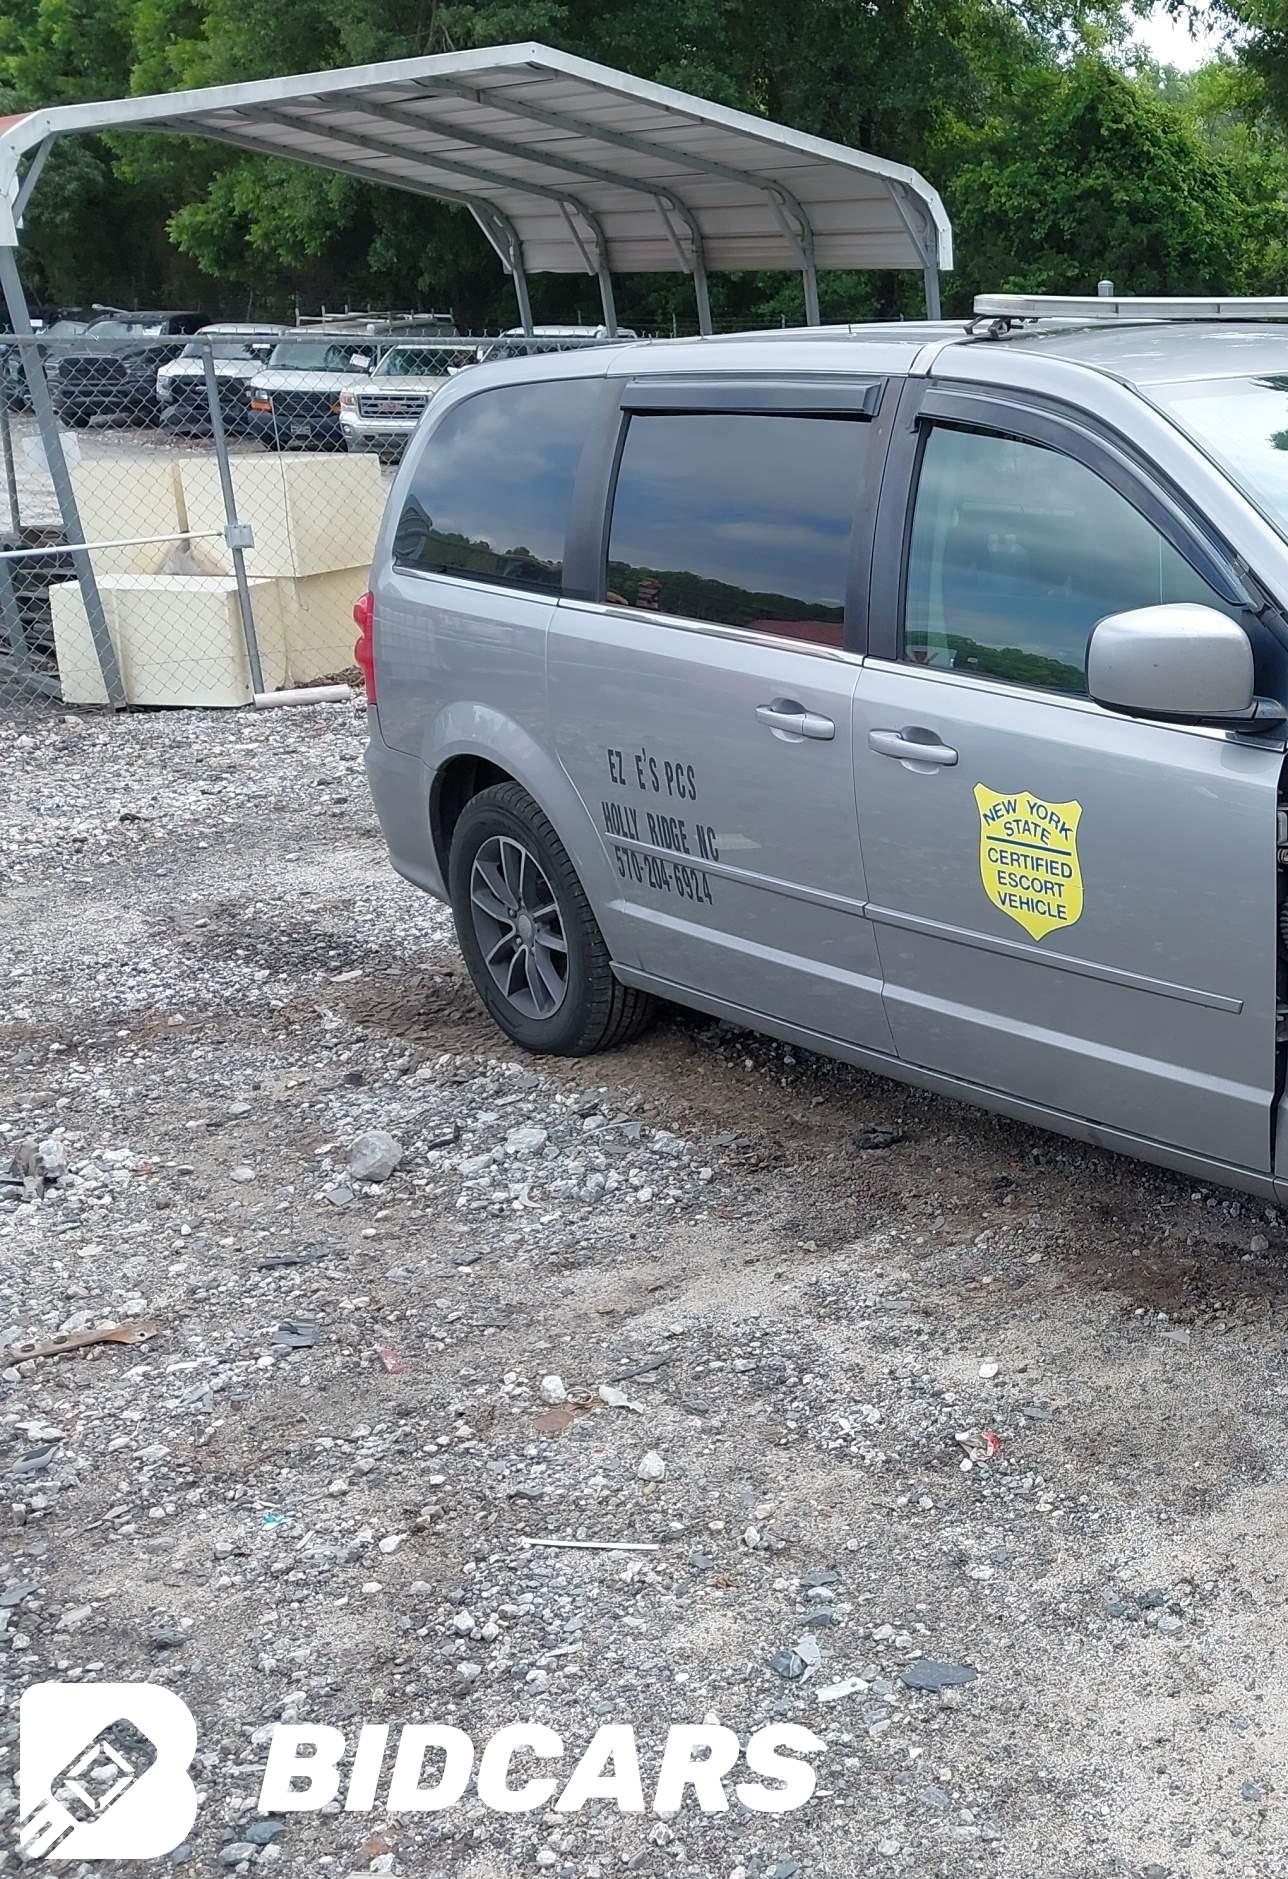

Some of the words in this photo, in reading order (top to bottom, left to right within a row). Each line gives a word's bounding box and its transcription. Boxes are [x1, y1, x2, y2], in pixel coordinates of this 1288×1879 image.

[607, 748, 626, 785] EZ
[664, 760, 697, 800] PCS
[601, 801, 639, 841] HOLLY
[646, 812, 690, 854] RIDGE
[696, 824, 719, 862] NC
[983, 799, 1017, 826] NEW
[1027, 799, 1073, 841] YORK
[1004, 819, 1051, 845] STATE
[988, 847, 1072, 878] CERTIFIED
[997, 870, 1064, 898] ESCORT
[997, 891, 1067, 920] VEHICLE
